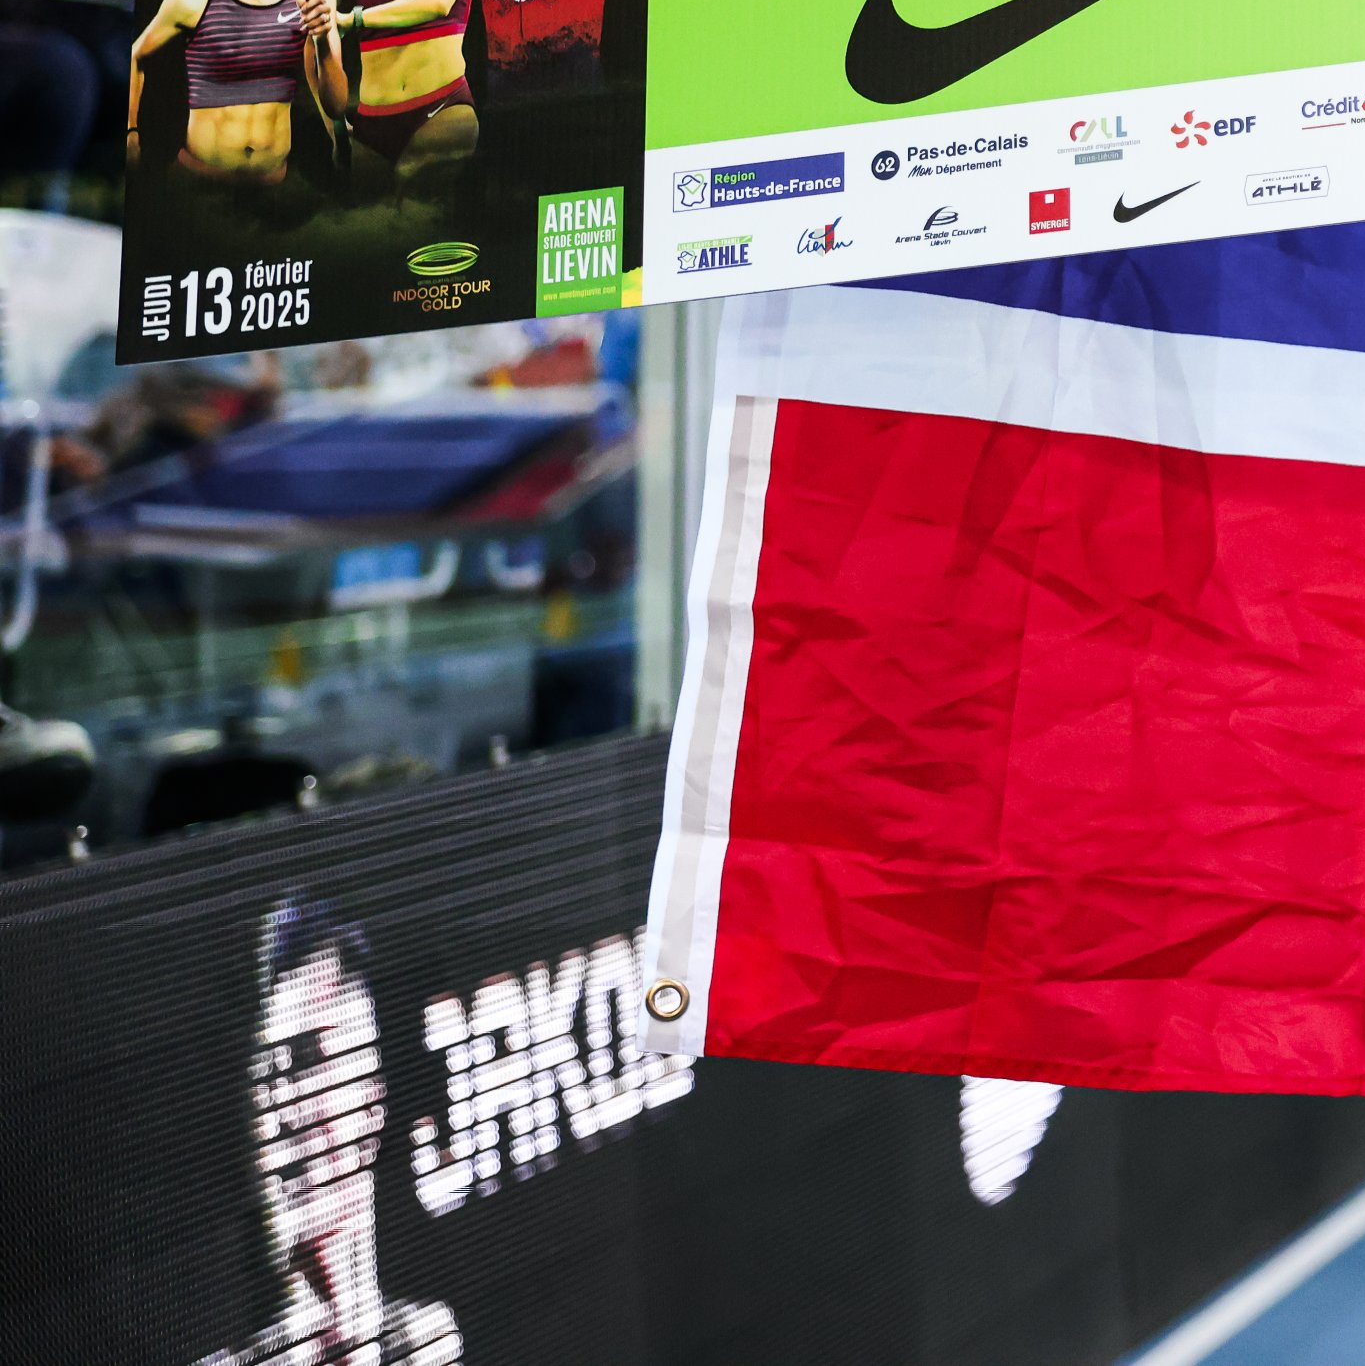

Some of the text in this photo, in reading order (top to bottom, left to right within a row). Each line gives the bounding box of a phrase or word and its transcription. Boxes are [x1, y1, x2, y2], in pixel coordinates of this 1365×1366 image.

[1301, 95, 1360, 119] Crédit
[714, 170, 756, 186] Région
[907, 158, 1002, 179] Mon Département
[714, 176, 842, 203] Hauts-de-France
[543, 196, 617, 234] ARENA
[1030, 218, 1070, 231] SYNERGIE
[543, 228, 616, 250] STADE COUVERT
[895, 225, 987, 244] Arena Stade Couvert
[543, 244, 617, 284] LIEVIN
[698, 243, 749, 269] ATHLE
[244, 257, 314, 290] février
[179, 266, 234, 338] 13
[393, 284, 449, 302] INDOOR
[452, 279, 491, 296] TOUR
[142, 274, 172, 342] JEUDI
[240, 288, 310, 332] 2025
[421, 296, 462, 312] GOLD
